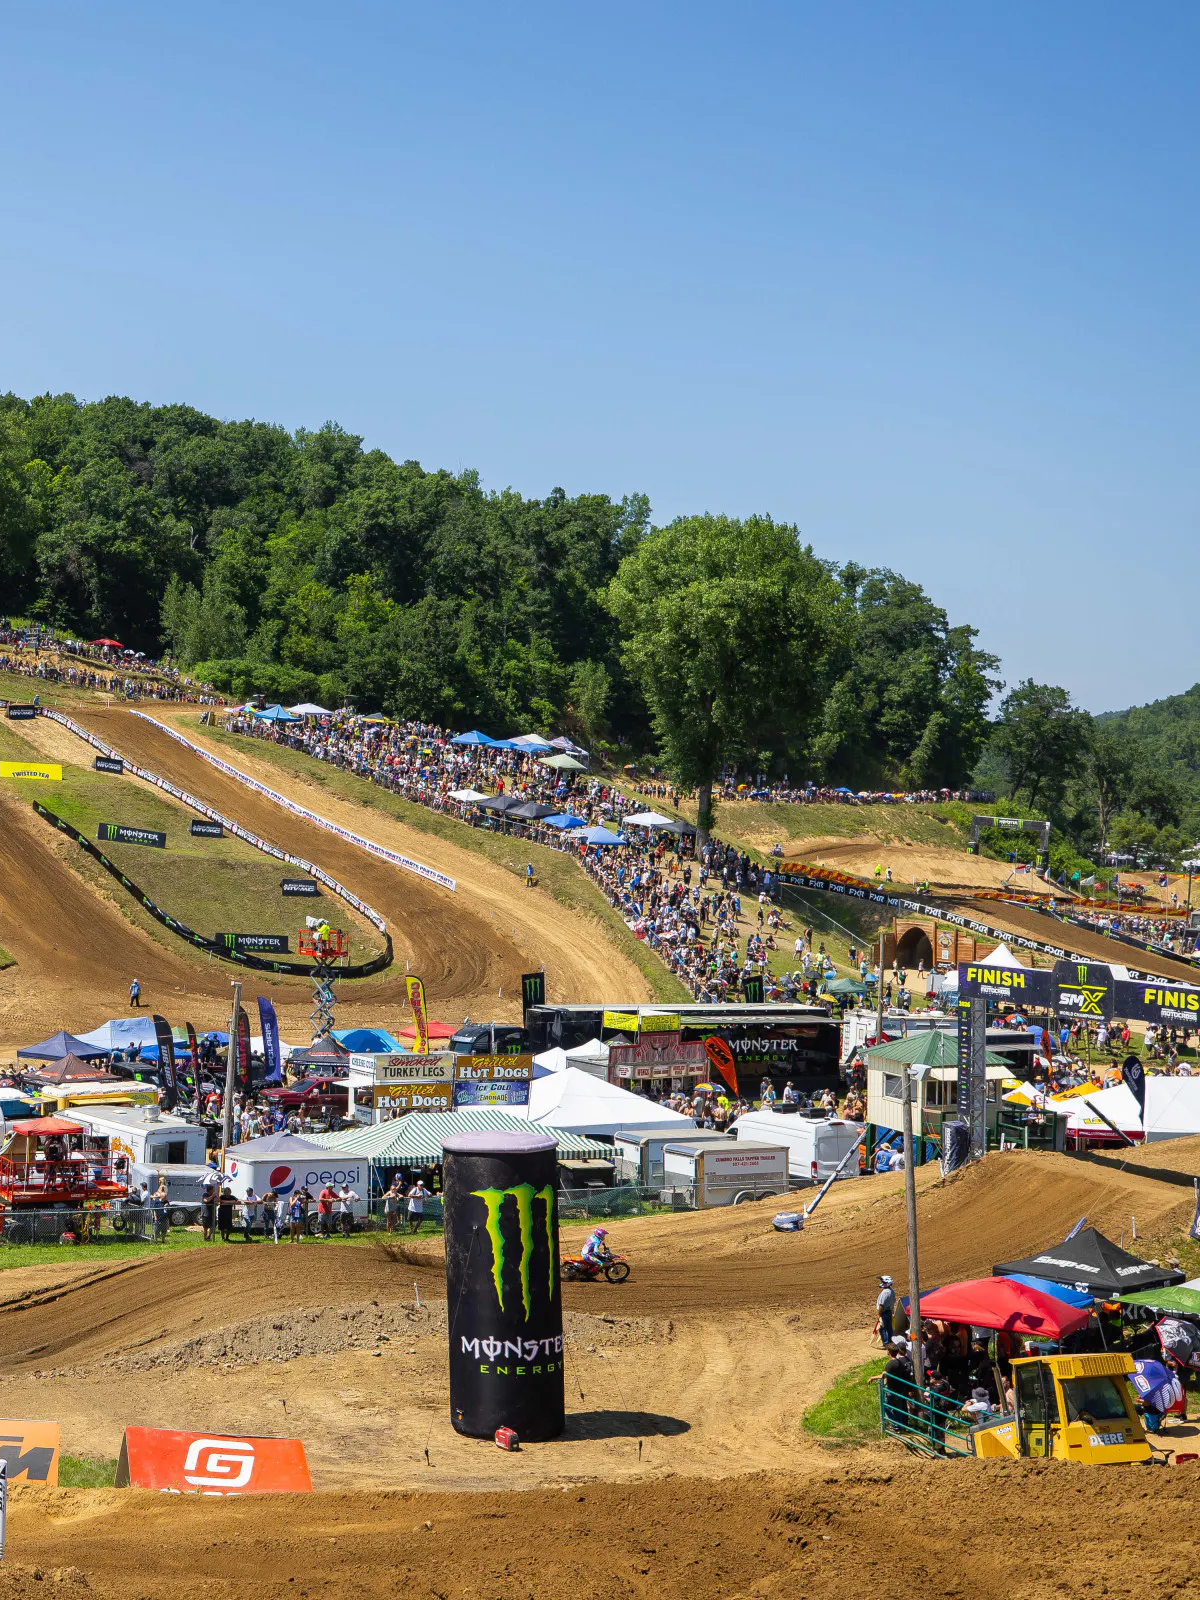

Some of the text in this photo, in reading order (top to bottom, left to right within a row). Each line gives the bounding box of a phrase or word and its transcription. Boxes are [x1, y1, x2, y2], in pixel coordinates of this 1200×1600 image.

[119, 829, 159, 841] MONSTER
[238, 937, 281, 946] MONSTER
[967, 967, 1025, 988] FINISH
[729, 1038, 798, 1053] MONSTER
[471, 1056, 517, 1067] Grilled
[383, 1067, 444, 1077] TURKEY LEGS
[459, 1066, 529, 1079] HOT DOGS
[389, 1085, 436, 1096] Grilled
[491, 1083, 512, 1091] COLD
[377, 1096, 408, 1108] HOT
[412, 1095, 448, 1107] DOGS
[477, 1094, 508, 1102] LEMONADE
[306, 1167, 360, 1185] pepsi
[1032, 1256, 1100, 1274] Snap-on
[1089, 1432, 1124, 1447] DEERE
